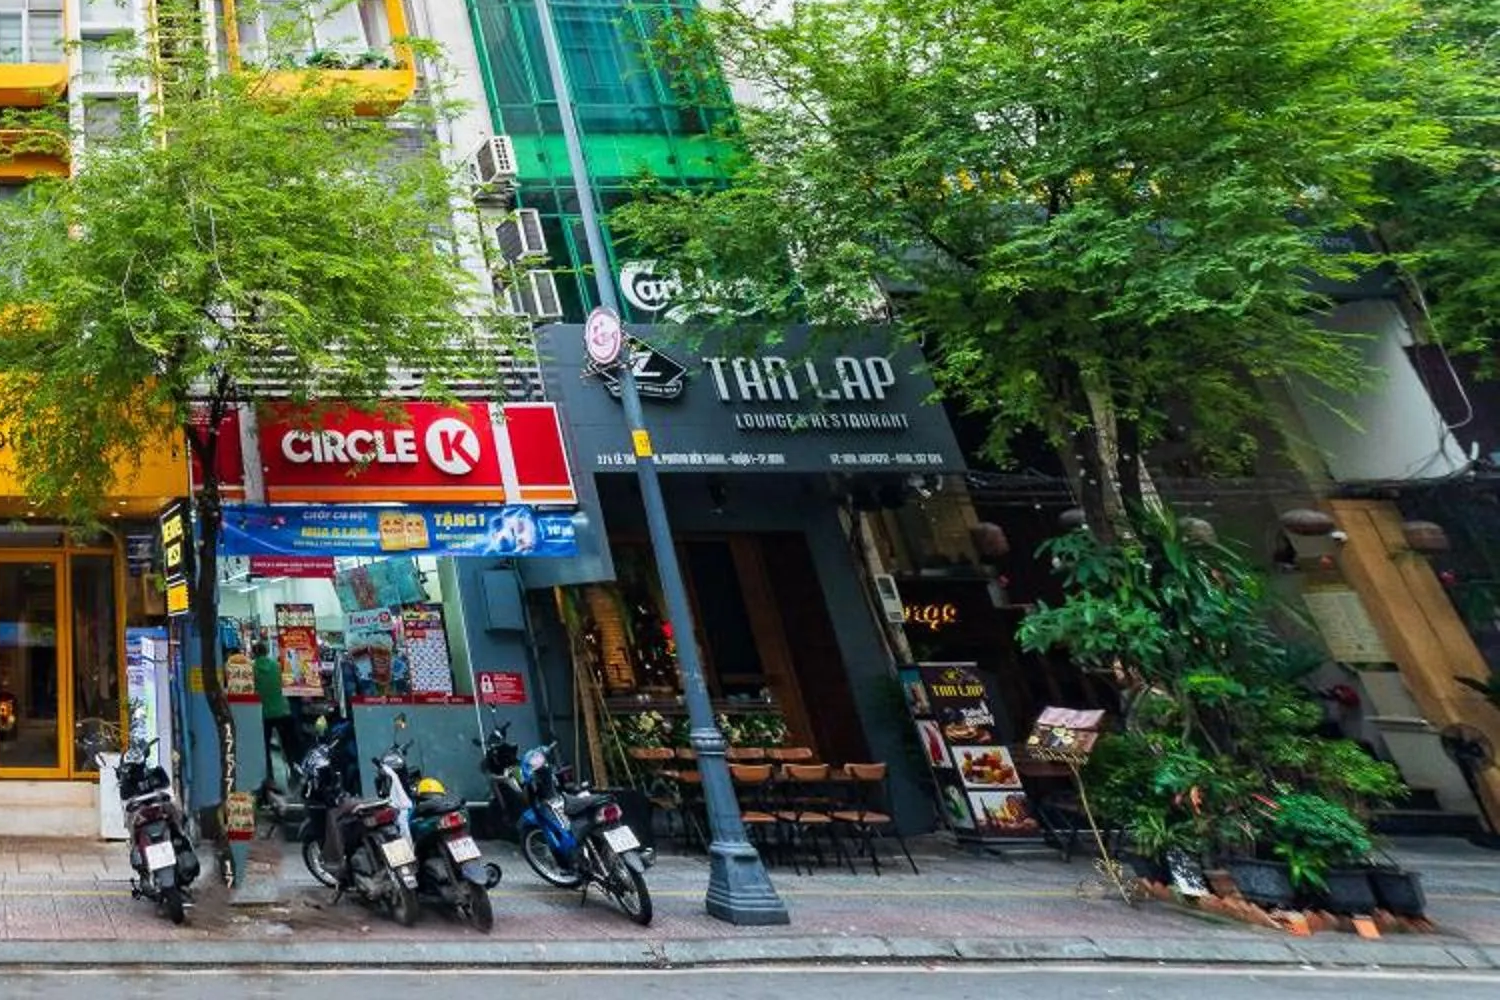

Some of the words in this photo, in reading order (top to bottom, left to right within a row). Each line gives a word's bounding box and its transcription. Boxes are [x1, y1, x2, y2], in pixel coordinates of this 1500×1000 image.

[703, 356, 799, 400] TAN
[804, 356, 896, 400] LAP
[281, 429, 419, 464] CIRCLE
[437, 426, 479, 467] K
